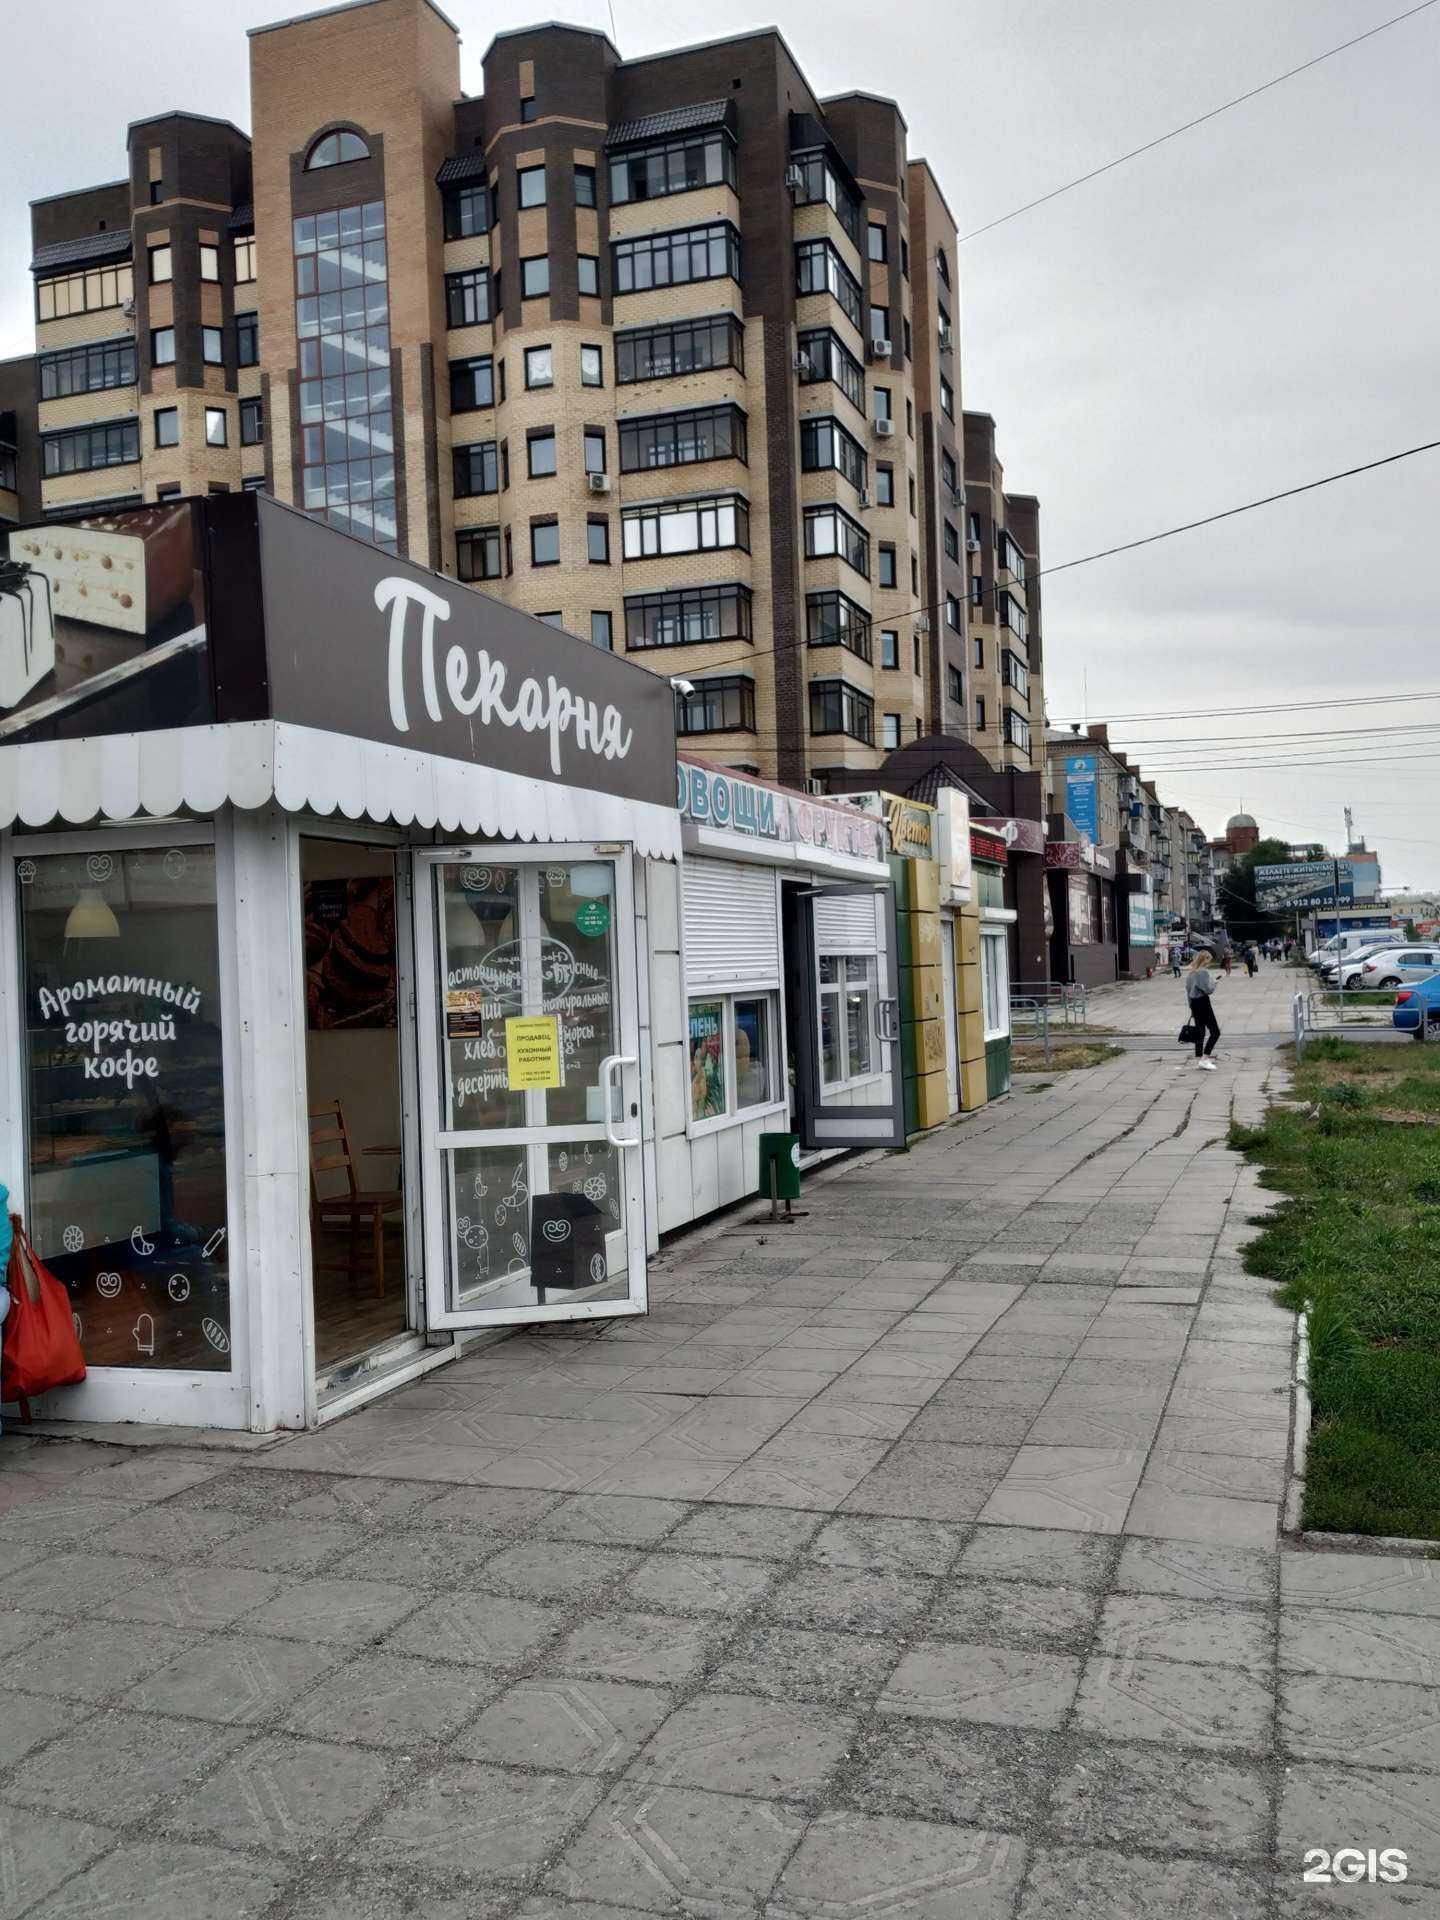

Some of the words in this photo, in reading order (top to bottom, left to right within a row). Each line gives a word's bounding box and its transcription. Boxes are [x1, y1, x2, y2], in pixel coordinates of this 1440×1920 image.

[374, 576, 633, 776] Пекарня
[38, 975, 202, 1020] Ароматный
[64, 1014, 177, 1054] горячий
[83, 1048, 160, 1090] кофе
